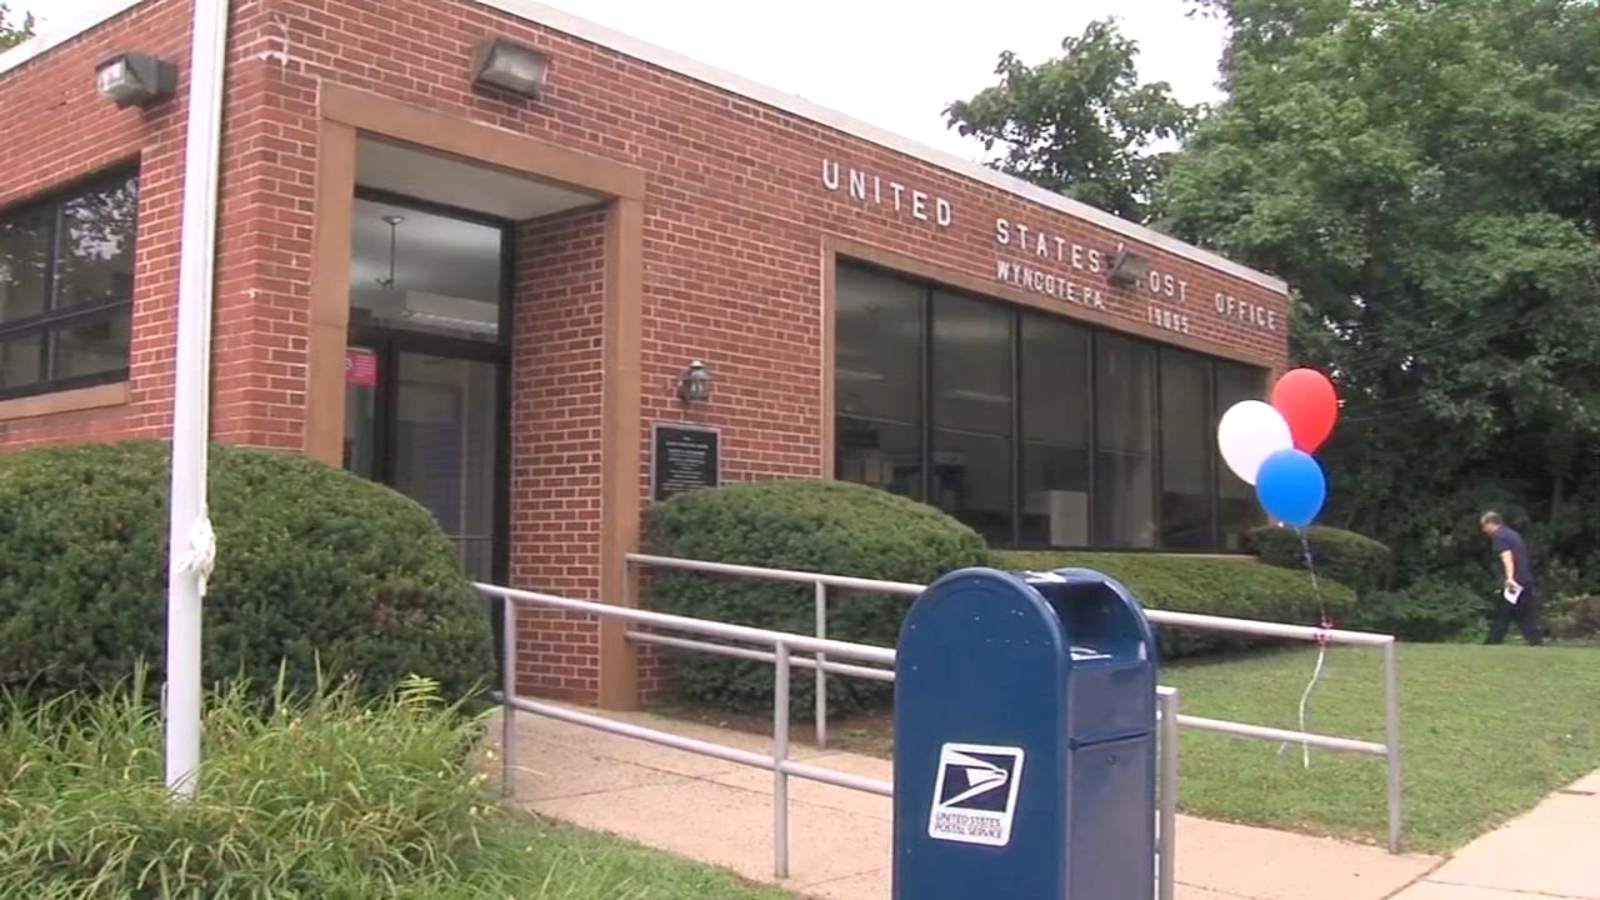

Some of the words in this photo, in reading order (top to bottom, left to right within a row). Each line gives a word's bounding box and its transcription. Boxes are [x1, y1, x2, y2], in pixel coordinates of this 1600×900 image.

[823, 159, 951, 226] UNITED
[996, 218, 1100, 273] STATES
[1135, 268, 1187, 301] OST
[1215, 293, 1277, 330] OFFICE
[997, 261, 1077, 301] WYNCOTE
[934, 822, 966, 835] POSTAL
[968, 827, 1002, 839] SERVICE
[935, 811, 969, 824] UNITED
[970, 816, 1001, 828] STATES
